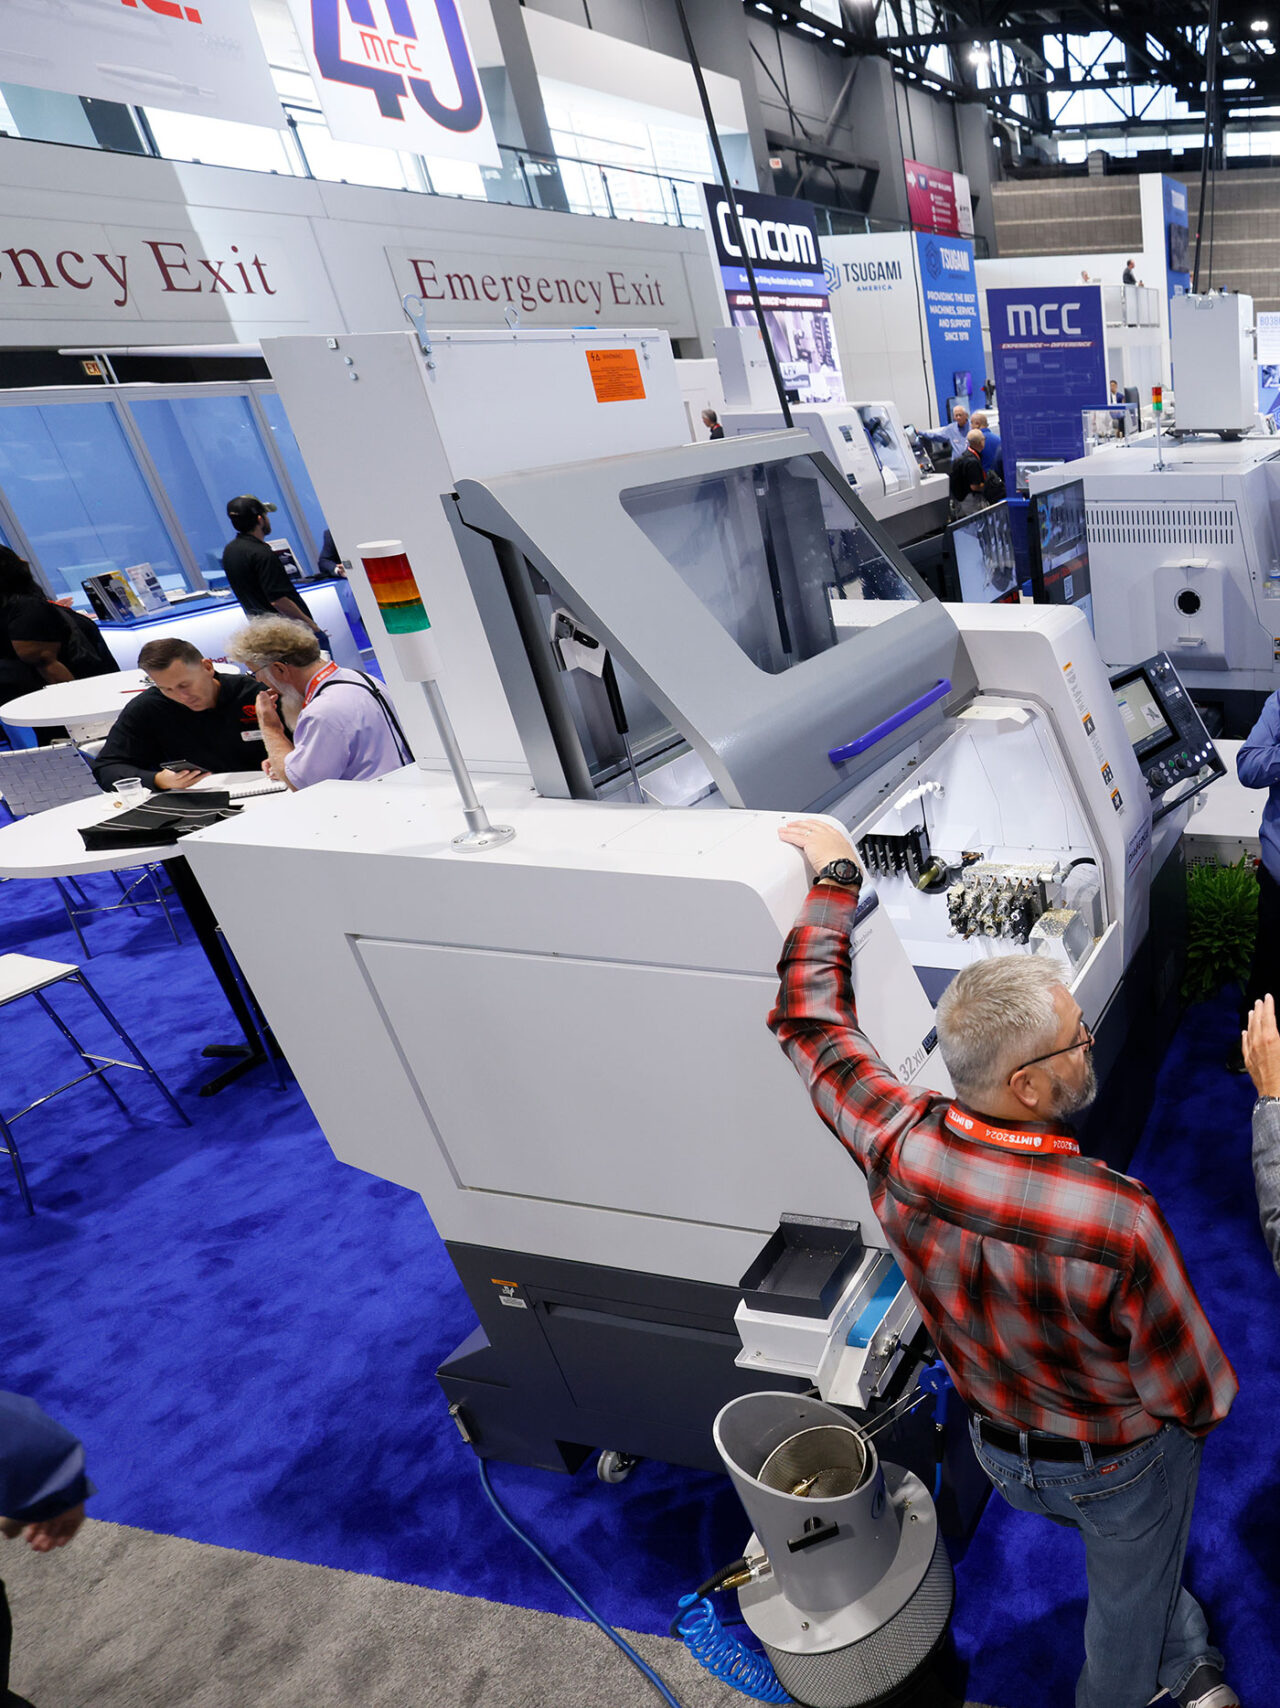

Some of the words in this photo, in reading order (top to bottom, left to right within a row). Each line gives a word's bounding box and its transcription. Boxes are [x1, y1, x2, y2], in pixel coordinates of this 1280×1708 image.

[716, 201, 817, 265] Cincom
[142, 240, 277, 295] Exit
[843, 260, 902, 283] TSUGAMI
[940, 247, 970, 272] TSUGAMI
[408, 258, 602, 315] Emergency
[607, 271, 665, 306] Exit
[856, 284, 893, 292] AMERICA
[985, 1129, 1033, 1146] IMTS2024
